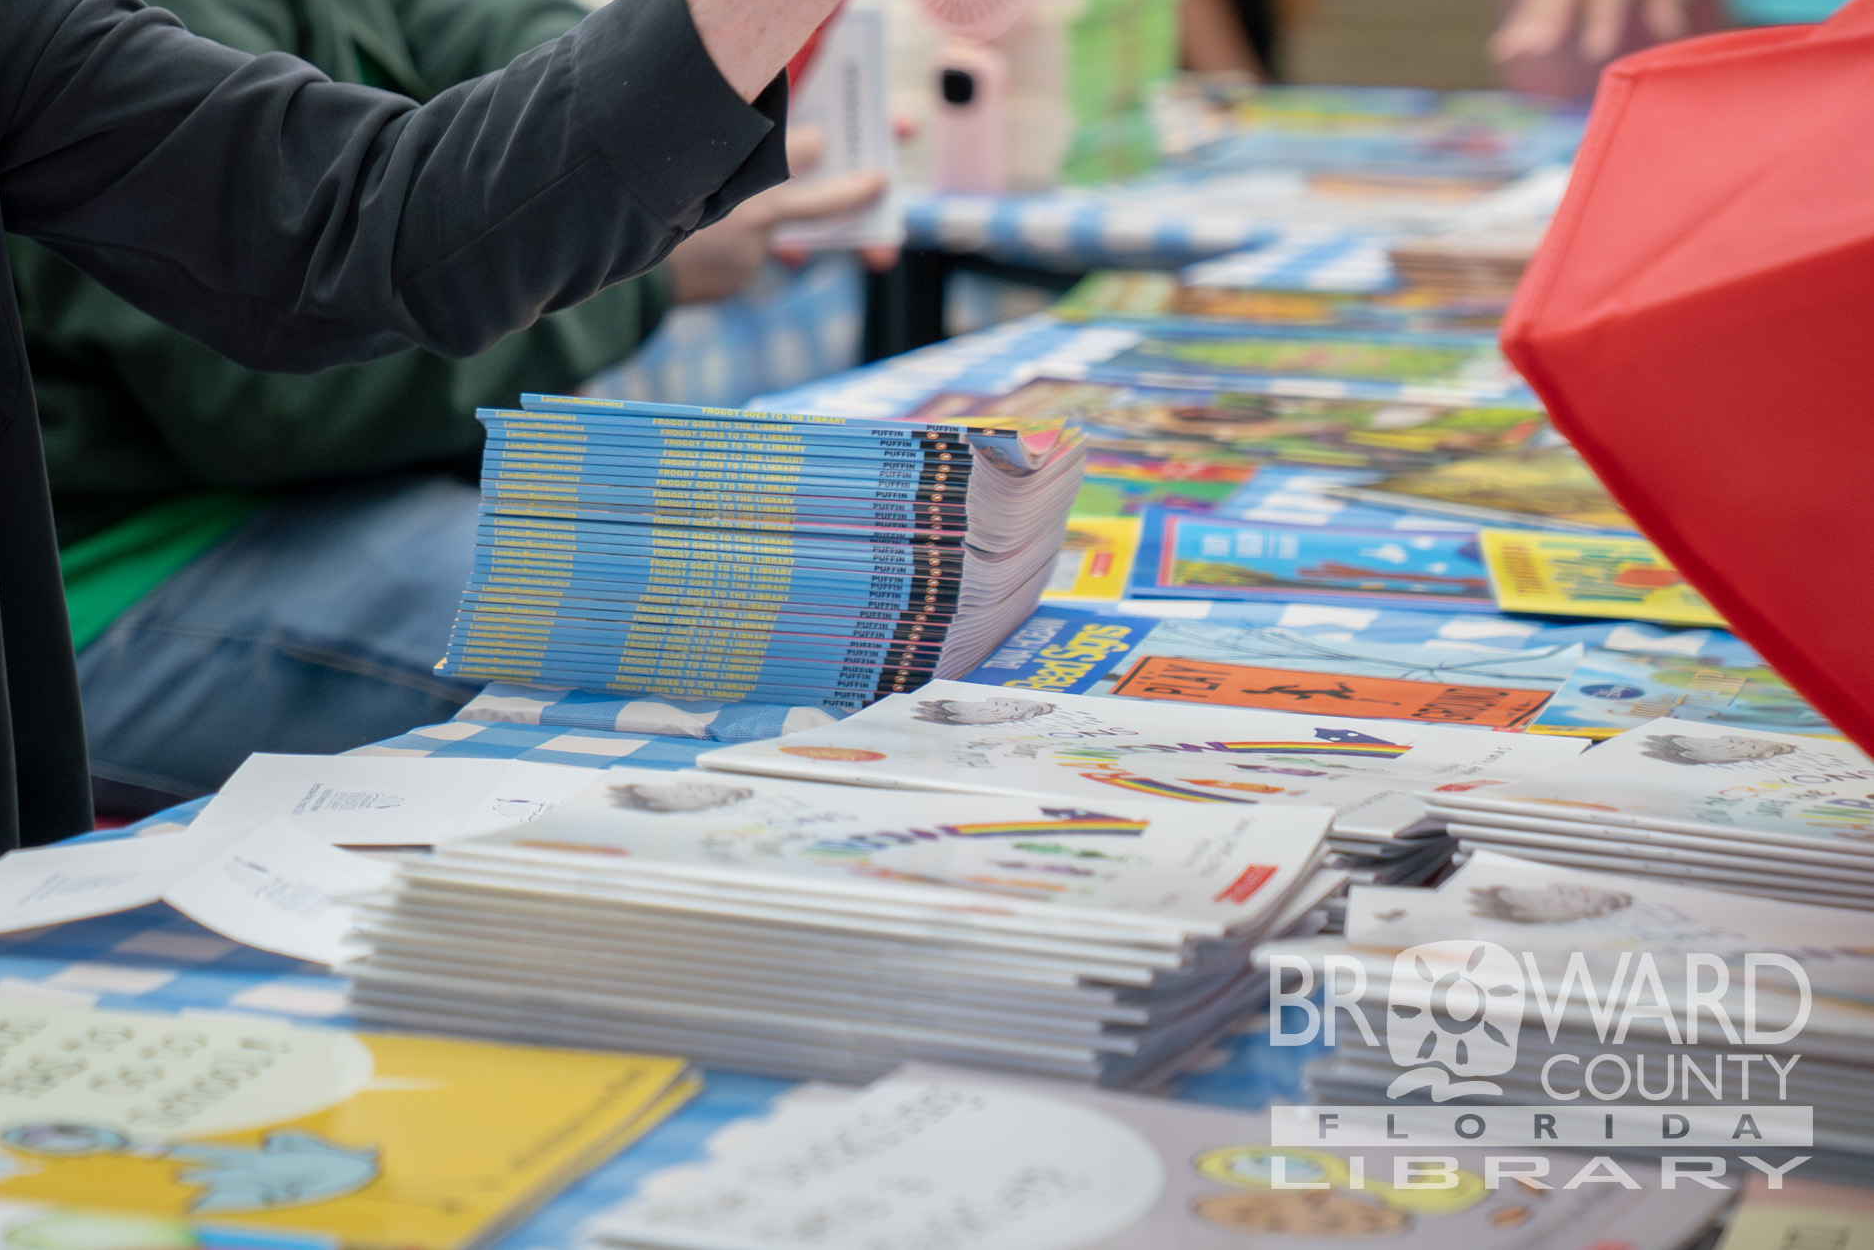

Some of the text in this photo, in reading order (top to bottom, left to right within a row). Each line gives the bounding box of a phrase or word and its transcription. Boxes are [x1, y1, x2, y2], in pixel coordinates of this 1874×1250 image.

[540, 396, 623, 407] London/Remkiewicz
[702, 407, 740, 416] FROGGY
[743, 410, 768, 418] GOES
[785, 413, 806, 421] THE
[809, 415, 846, 424] LIBRARY
[873, 503, 904, 511] PUFFIN
[875, 565, 906, 573] PUFFIN
[1142, 663, 1232, 698] PLAY
